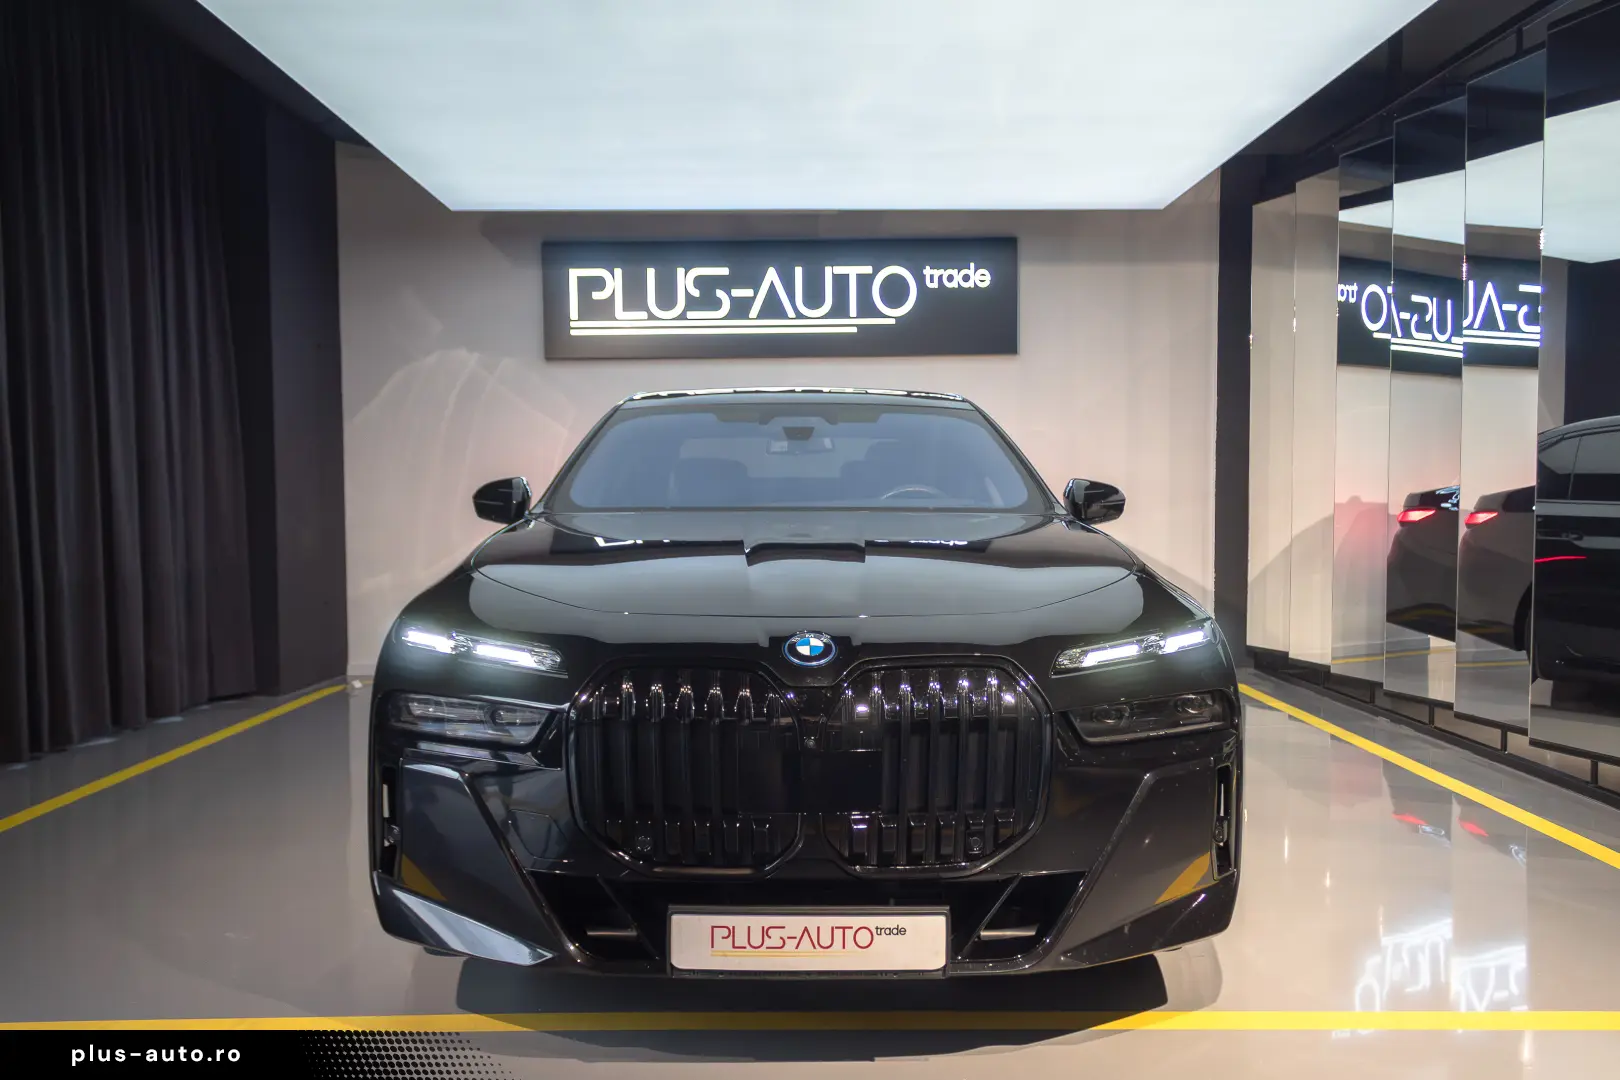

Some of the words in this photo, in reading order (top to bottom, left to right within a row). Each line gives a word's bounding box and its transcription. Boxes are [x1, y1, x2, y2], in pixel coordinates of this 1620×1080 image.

[568, 265, 918, 320] PLUS-AUTO
[922, 263, 992, 289] trade
[711, 925, 874, 950] PLUS-AUTO
[875, 925, 907, 936] trade
